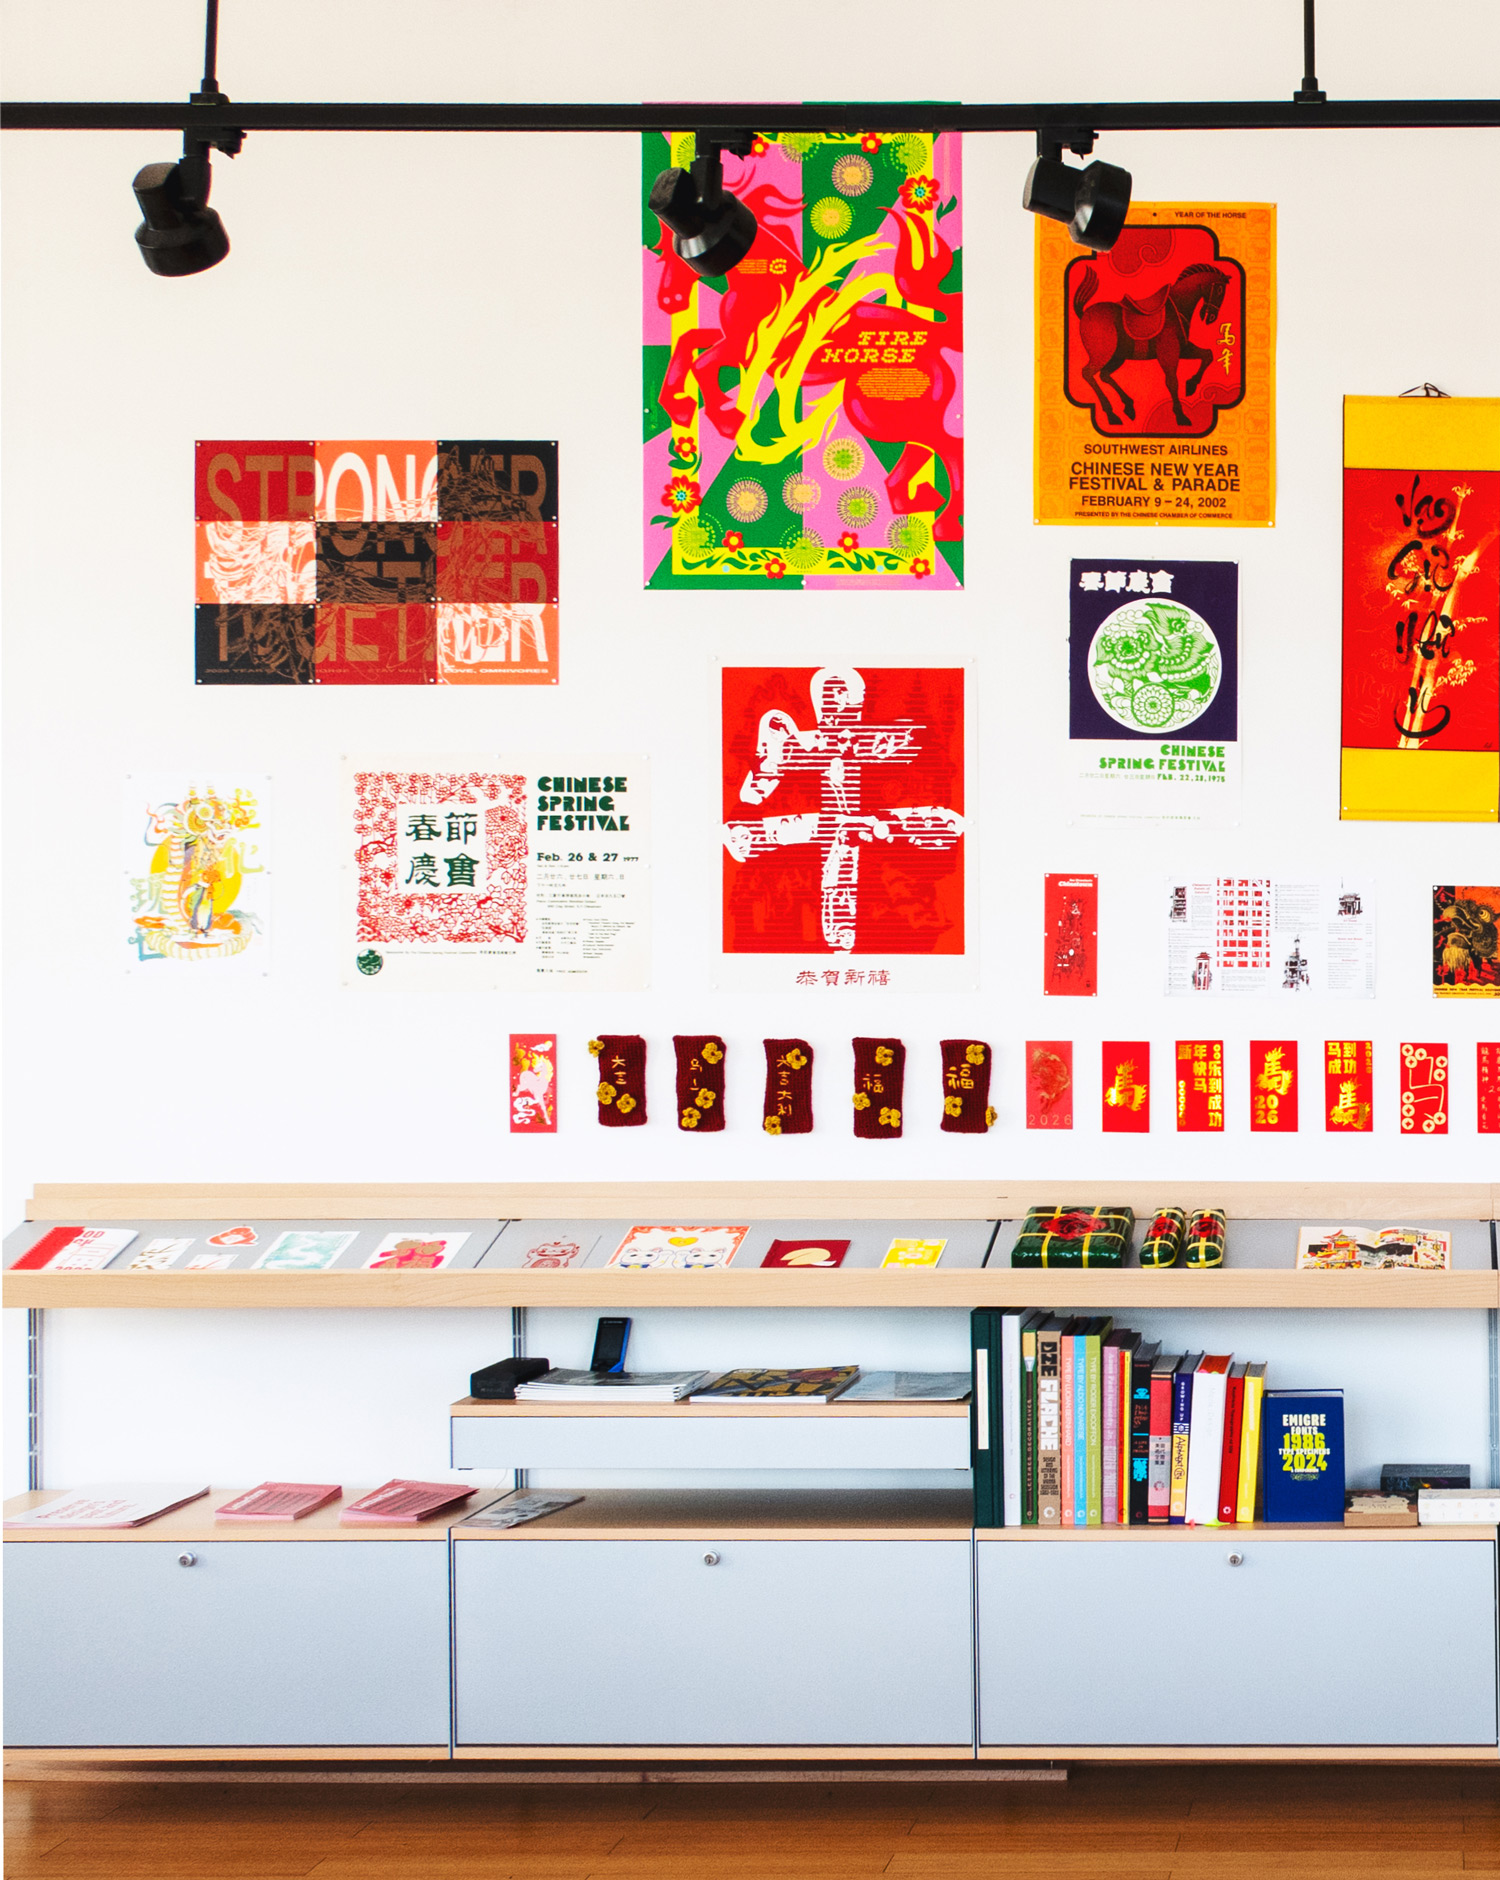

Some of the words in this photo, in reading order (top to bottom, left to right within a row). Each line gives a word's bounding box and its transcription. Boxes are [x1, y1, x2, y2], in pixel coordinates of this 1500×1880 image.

[858, 331, 928, 345] FIRE
[821, 348, 916, 363] HORSE
[1083, 443, 1165, 456] SOUTHWEST
[1168, 444, 1229, 456] AIRLINES
[1070, 462, 1145, 477] CHINESE
[1150, 462, 1191, 477] NEW
[1193, 463, 1239, 478] YEAR
[1068, 477, 1148, 491] FESTIVAL
[1153, 477, 1164, 491] &
[1172, 477, 1241, 492] PARADE
[1081, 495, 1151, 508] FEBRUARY
[1154, 495, 1161, 508] 9
[1175, 496, 1194, 509] 24,
[1198, 497, 1227, 508] 2002
[1120, 511, 1132, 519] THE
[1159, 743, 1226, 758] CHINESE
[1099, 757, 1155, 770] SPRING
[1158, 759, 1226, 773] FESTIVAL
[536, 776, 628, 793] CHINESE
[537, 795, 615, 812] SPRING
[536, 815, 630, 832] FESTIVAL
[536, 852, 563, 862] Feb.
[568, 852, 583, 862] 26
[588, 852, 598, 862] &
[602, 852, 618, 862] 27
[795, 968, 891, 987] 恭賀新禧
[1028, 1114, 1072, 1126] 2026
[1040, 1341, 1058, 1377] DIE
[1077, 1357, 1085, 1373] TYPE
[1065, 1374, 1072, 1383] BY
[1077, 1374, 1085, 1383] BY
[1090, 1374, 1097, 1383] BY
[1077, 1384, 1085, 1403] ALDO
[1077, 1403, 1085, 1440] NOVARESE
[1282, 1413, 1327, 1427] EMIGRE
[1290, 1426, 1319, 1435] FONTS
[1283, 1432, 1326, 1450] 1986
[1278, 1448, 1295, 1456] TYPE
[1295, 1448, 1331, 1456] SPECIMENS
[1282, 1453, 1328, 1472] 2024
